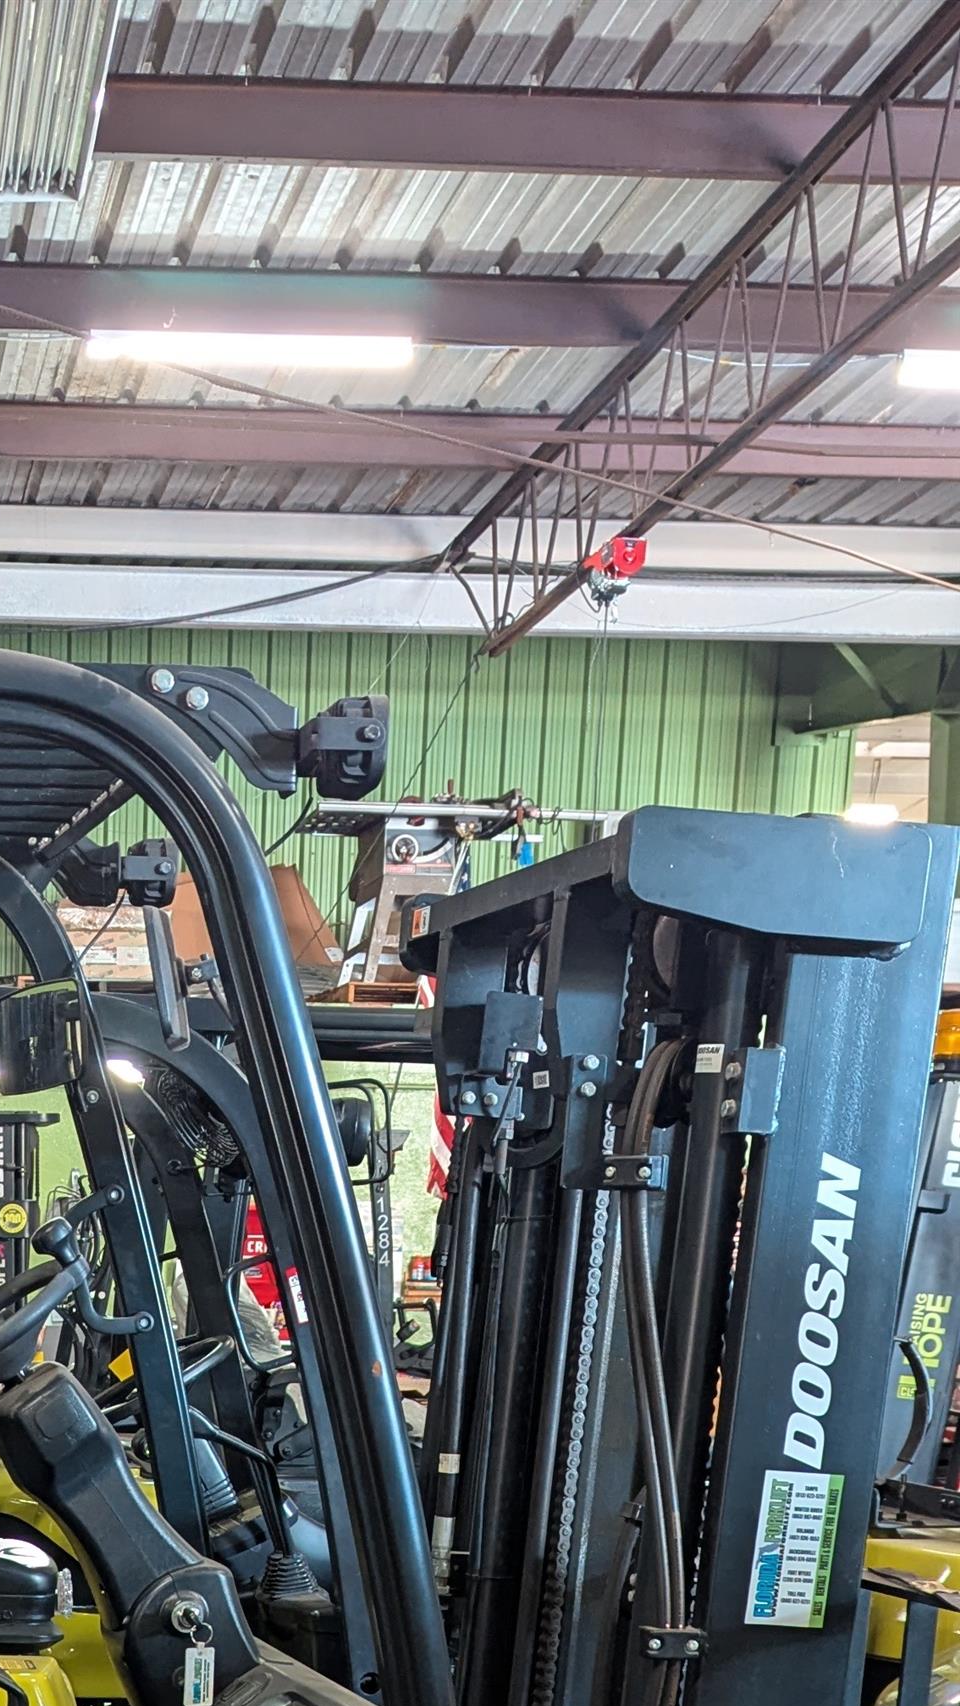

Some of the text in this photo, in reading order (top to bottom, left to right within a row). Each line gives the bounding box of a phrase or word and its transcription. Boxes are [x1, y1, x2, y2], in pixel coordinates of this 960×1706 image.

[783, 1152, 862, 1470] DOOSAN
[909, 1293, 928, 1346] AISING
[764, 1478, 789, 1543] FORKLIFT
